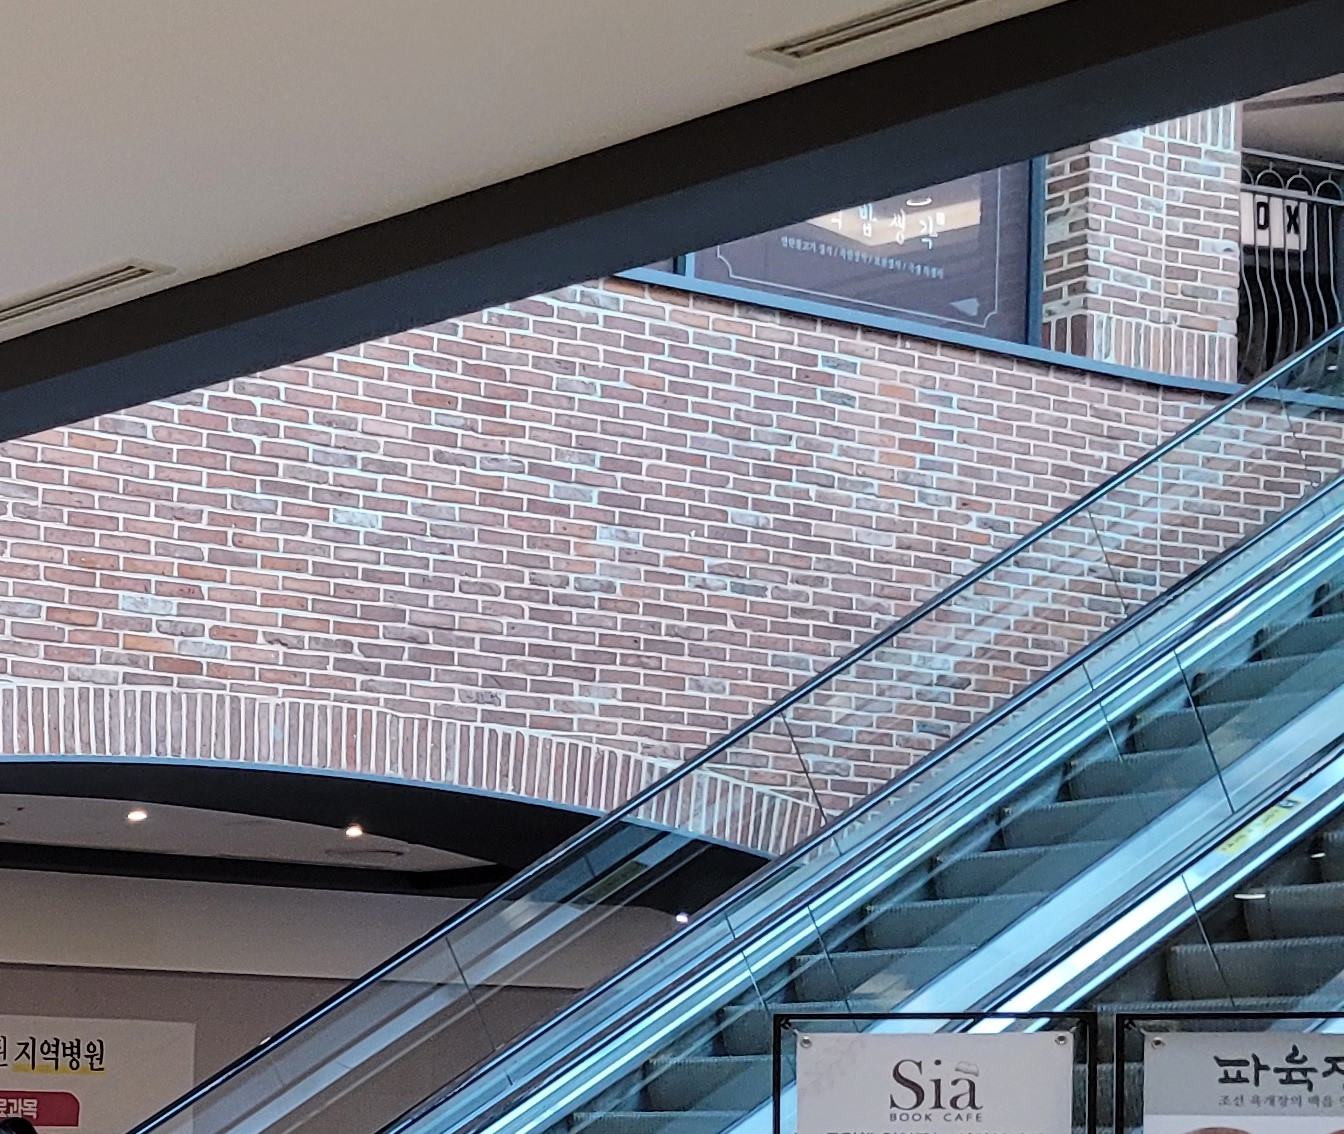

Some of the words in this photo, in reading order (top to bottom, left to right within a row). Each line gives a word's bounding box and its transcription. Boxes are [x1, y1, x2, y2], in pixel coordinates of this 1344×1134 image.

[13, 1036, 107, 1072] 지역병원
[889, 1059, 984, 1111] Sia
[889, 1113, 933, 1123] BOOK
[943, 1113, 984, 1123] CAFE
